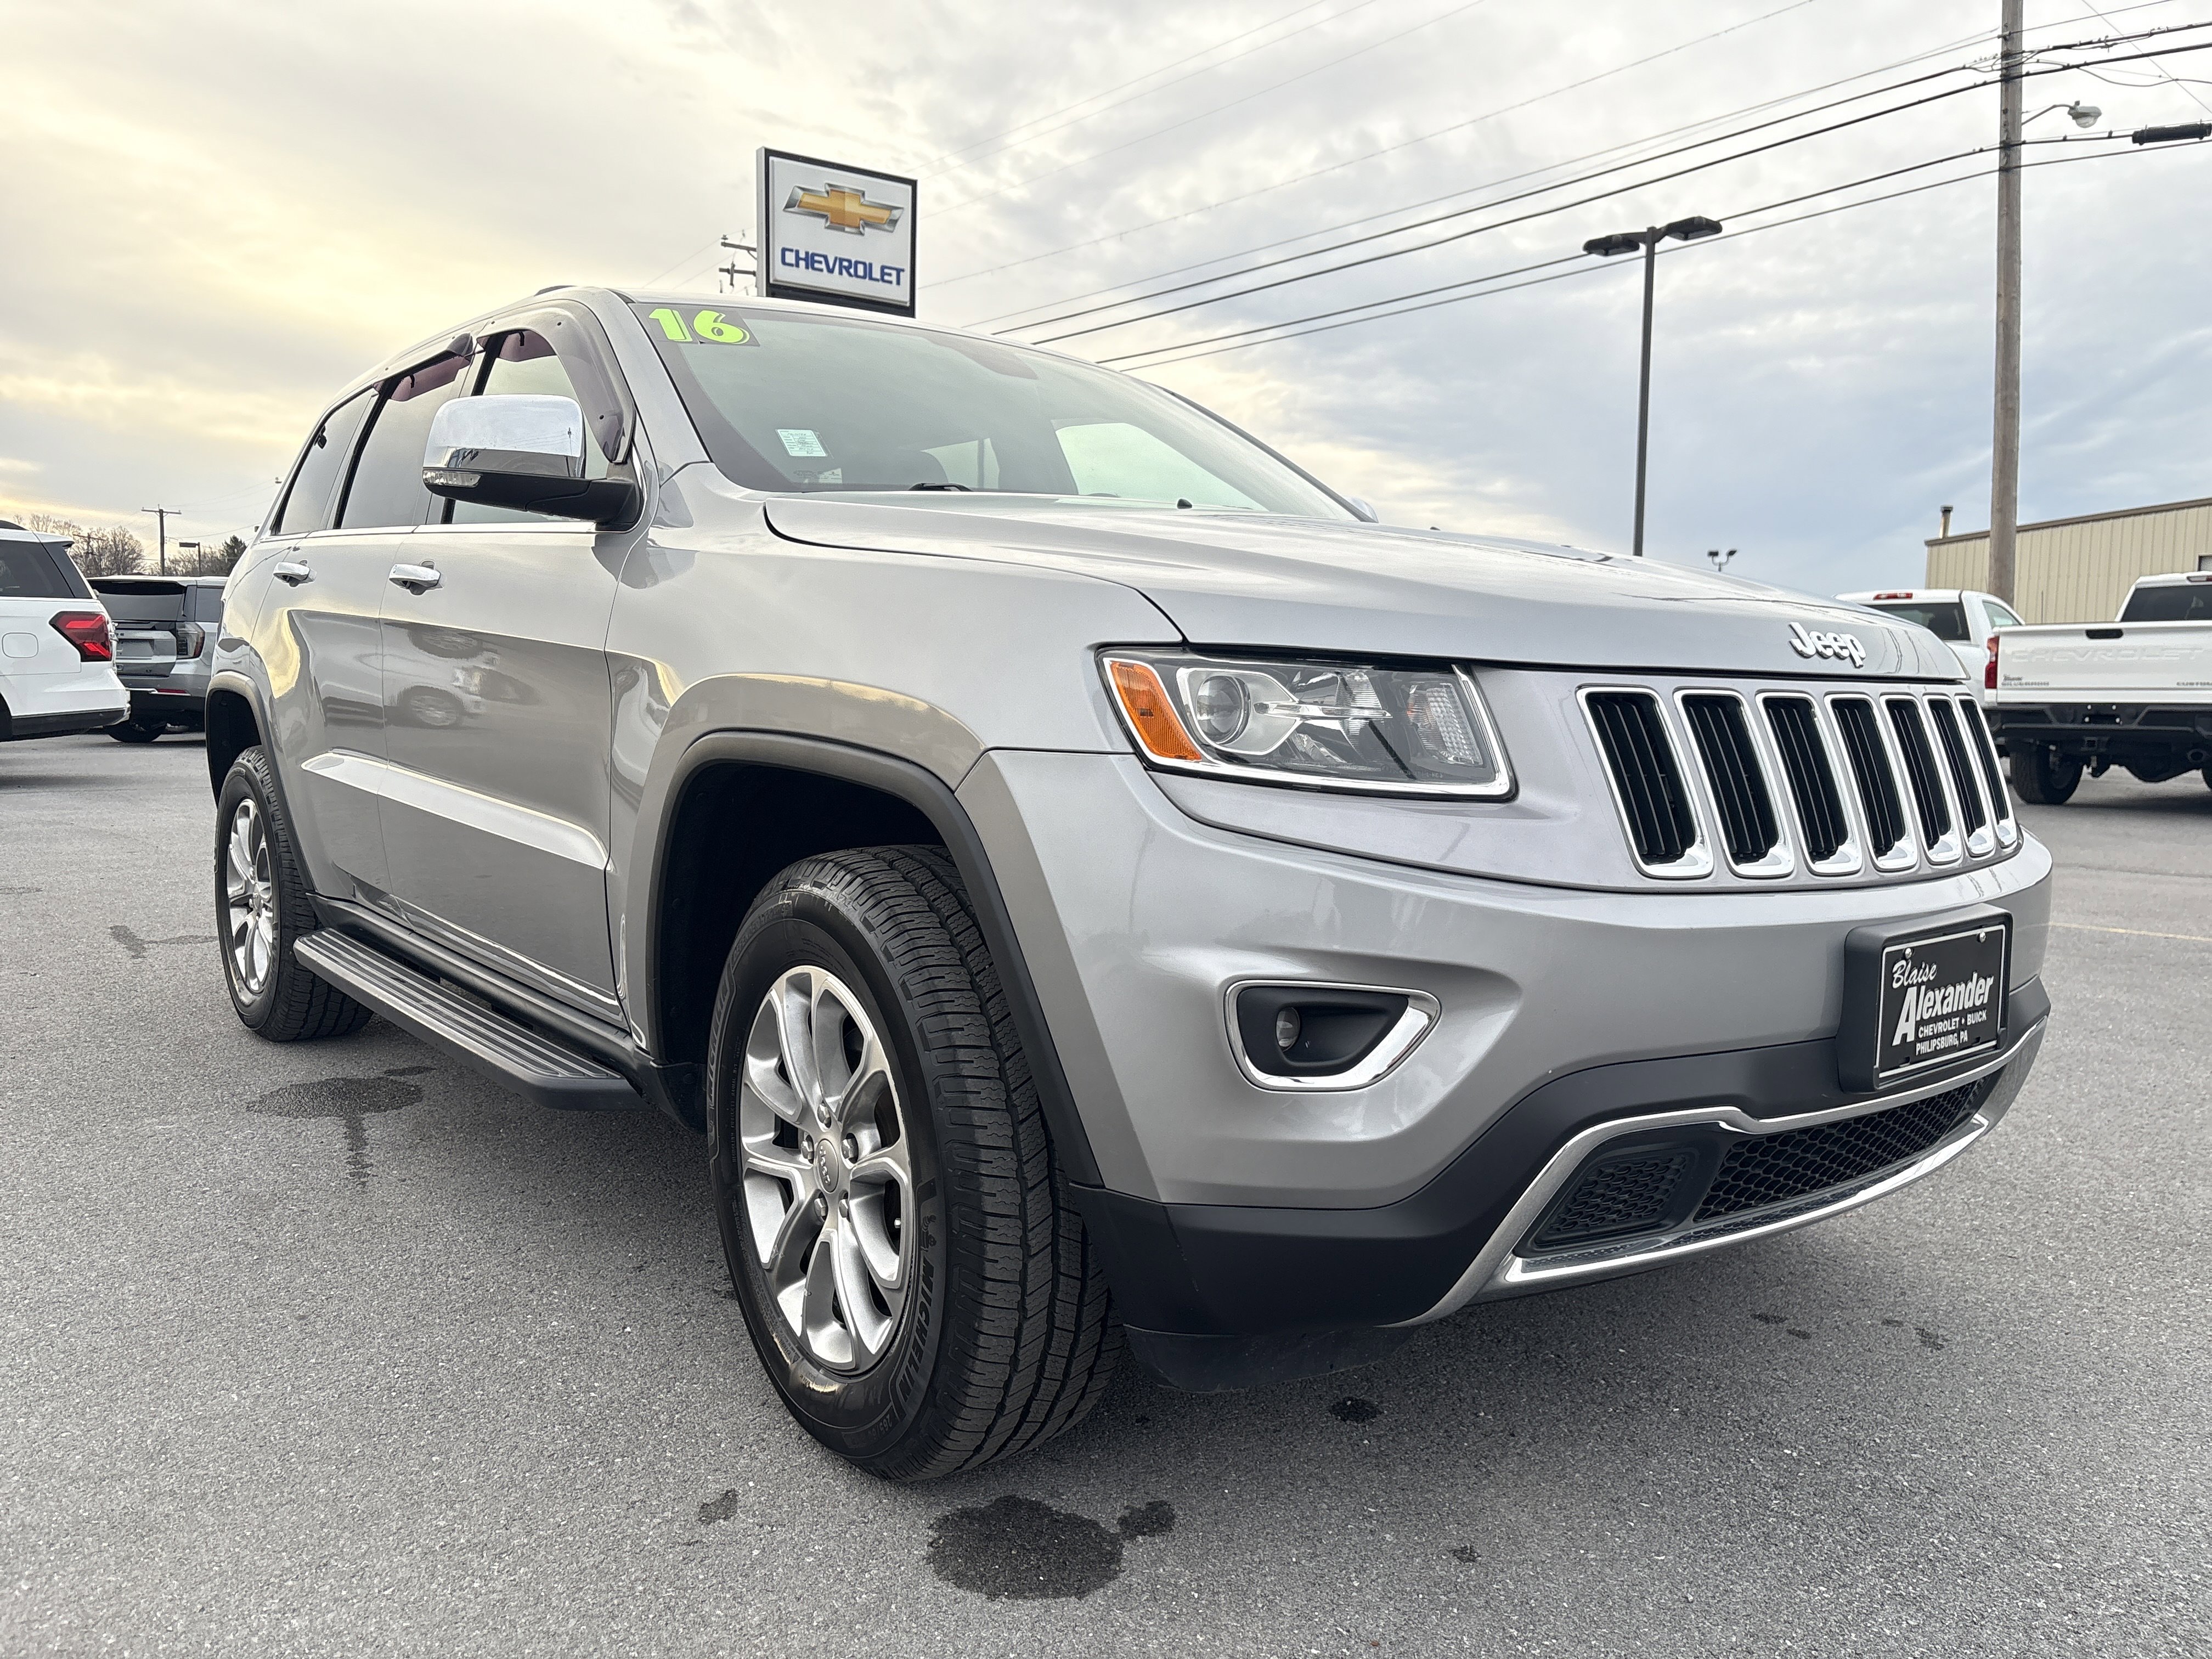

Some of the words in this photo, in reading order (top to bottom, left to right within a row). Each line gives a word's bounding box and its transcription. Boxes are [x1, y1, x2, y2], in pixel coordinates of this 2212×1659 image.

[780, 247, 905, 286] CHEVROLET
[648, 308, 750, 345] 16
[1787, 622, 1866, 669] Jeep
[1892, 960, 1938, 989] Blaise
[1892, 971, 1994, 1046] Alexander
[1918, 1017, 1960, 1039] CHEVROLET
[1966, 1009, 1987, 1026] BUICK
[1915, 1036, 1959, 1056] PHILIPSBURG,
[1959, 1031, 1968, 1043] PA
[819, 1146, 831, 1185] Jeep
[898, 1255, 934, 1402] MICHELIN
